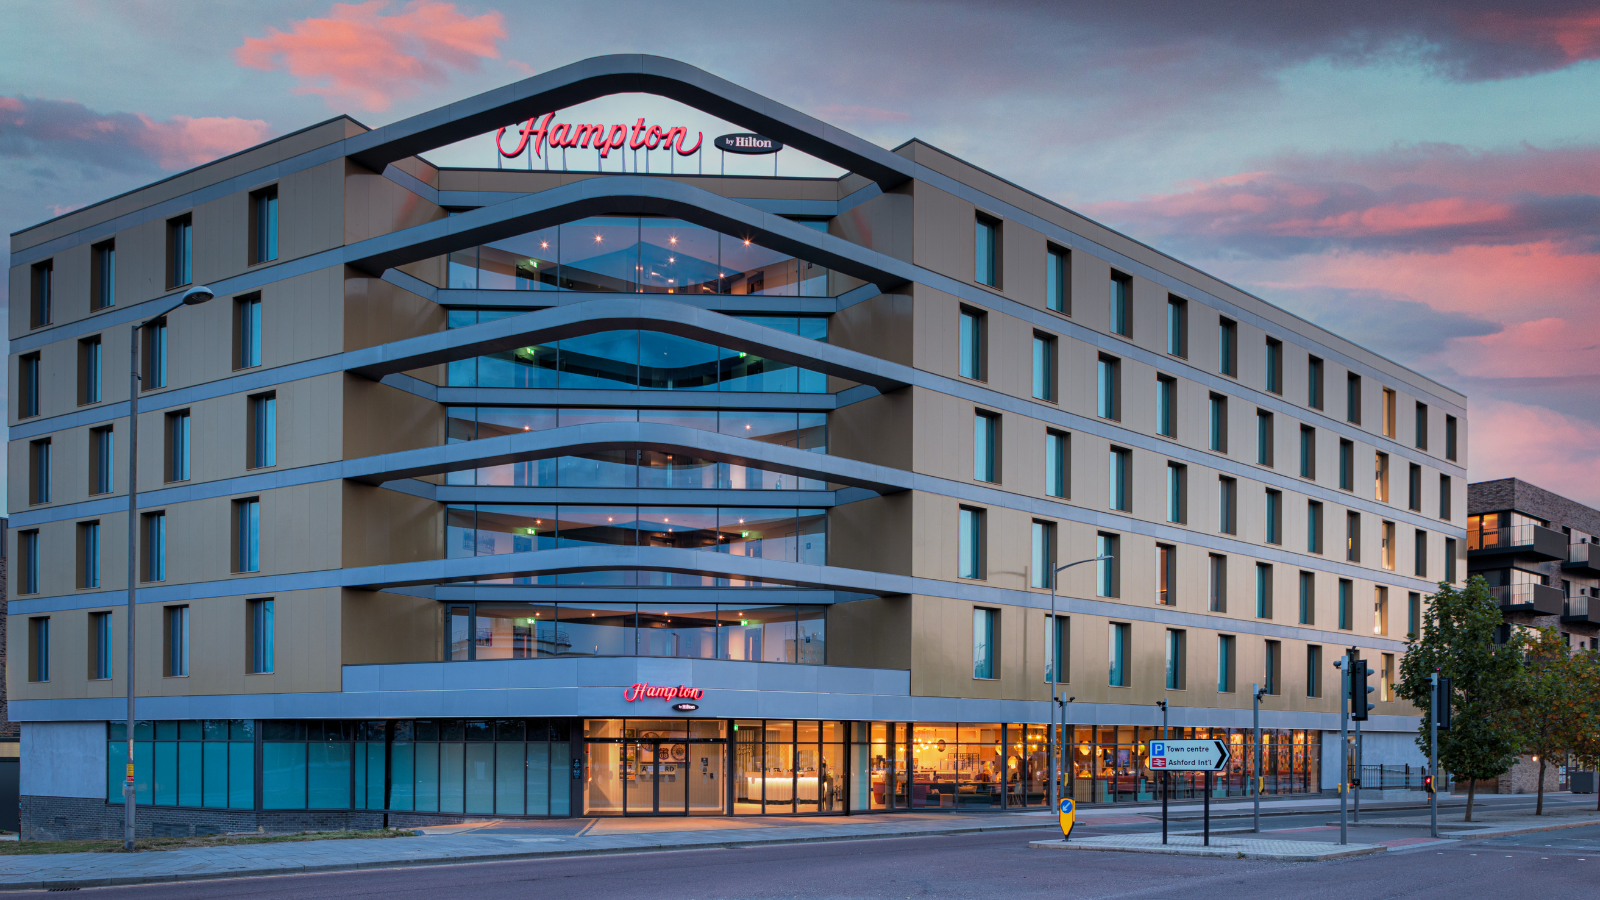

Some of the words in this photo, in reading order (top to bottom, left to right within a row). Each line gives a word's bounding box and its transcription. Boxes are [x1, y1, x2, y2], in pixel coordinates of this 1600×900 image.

[496, 111, 703, 159] Hampton
[725, 138, 735, 147] by
[735, 137, 772, 148] Hilton
[624, 682, 704, 702] Hampton
[1154, 744, 1163, 755] P
